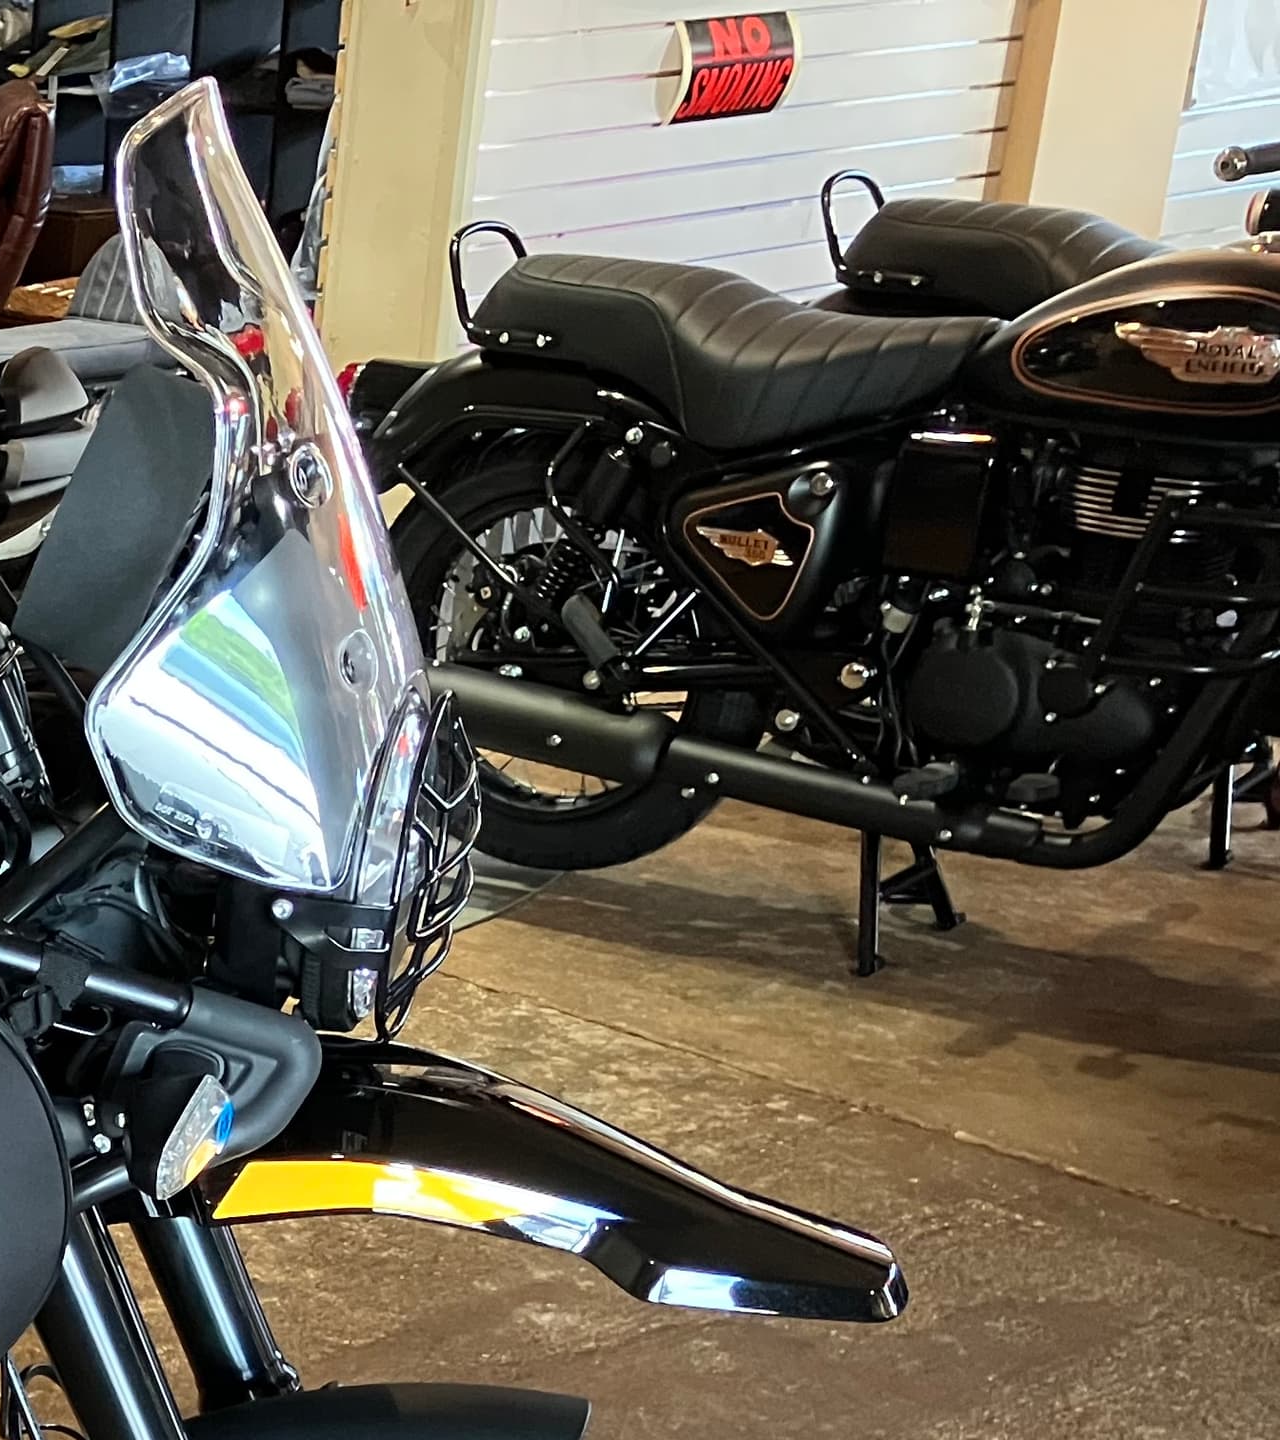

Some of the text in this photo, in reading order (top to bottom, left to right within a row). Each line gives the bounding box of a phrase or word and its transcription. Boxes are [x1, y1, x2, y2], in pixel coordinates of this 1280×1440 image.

[708, 17, 772, 61] NO
[675, 58, 794, 119] SMOKING
[1194, 338, 1264, 360] ROYAL
[720, 534, 769, 551] BULLET
